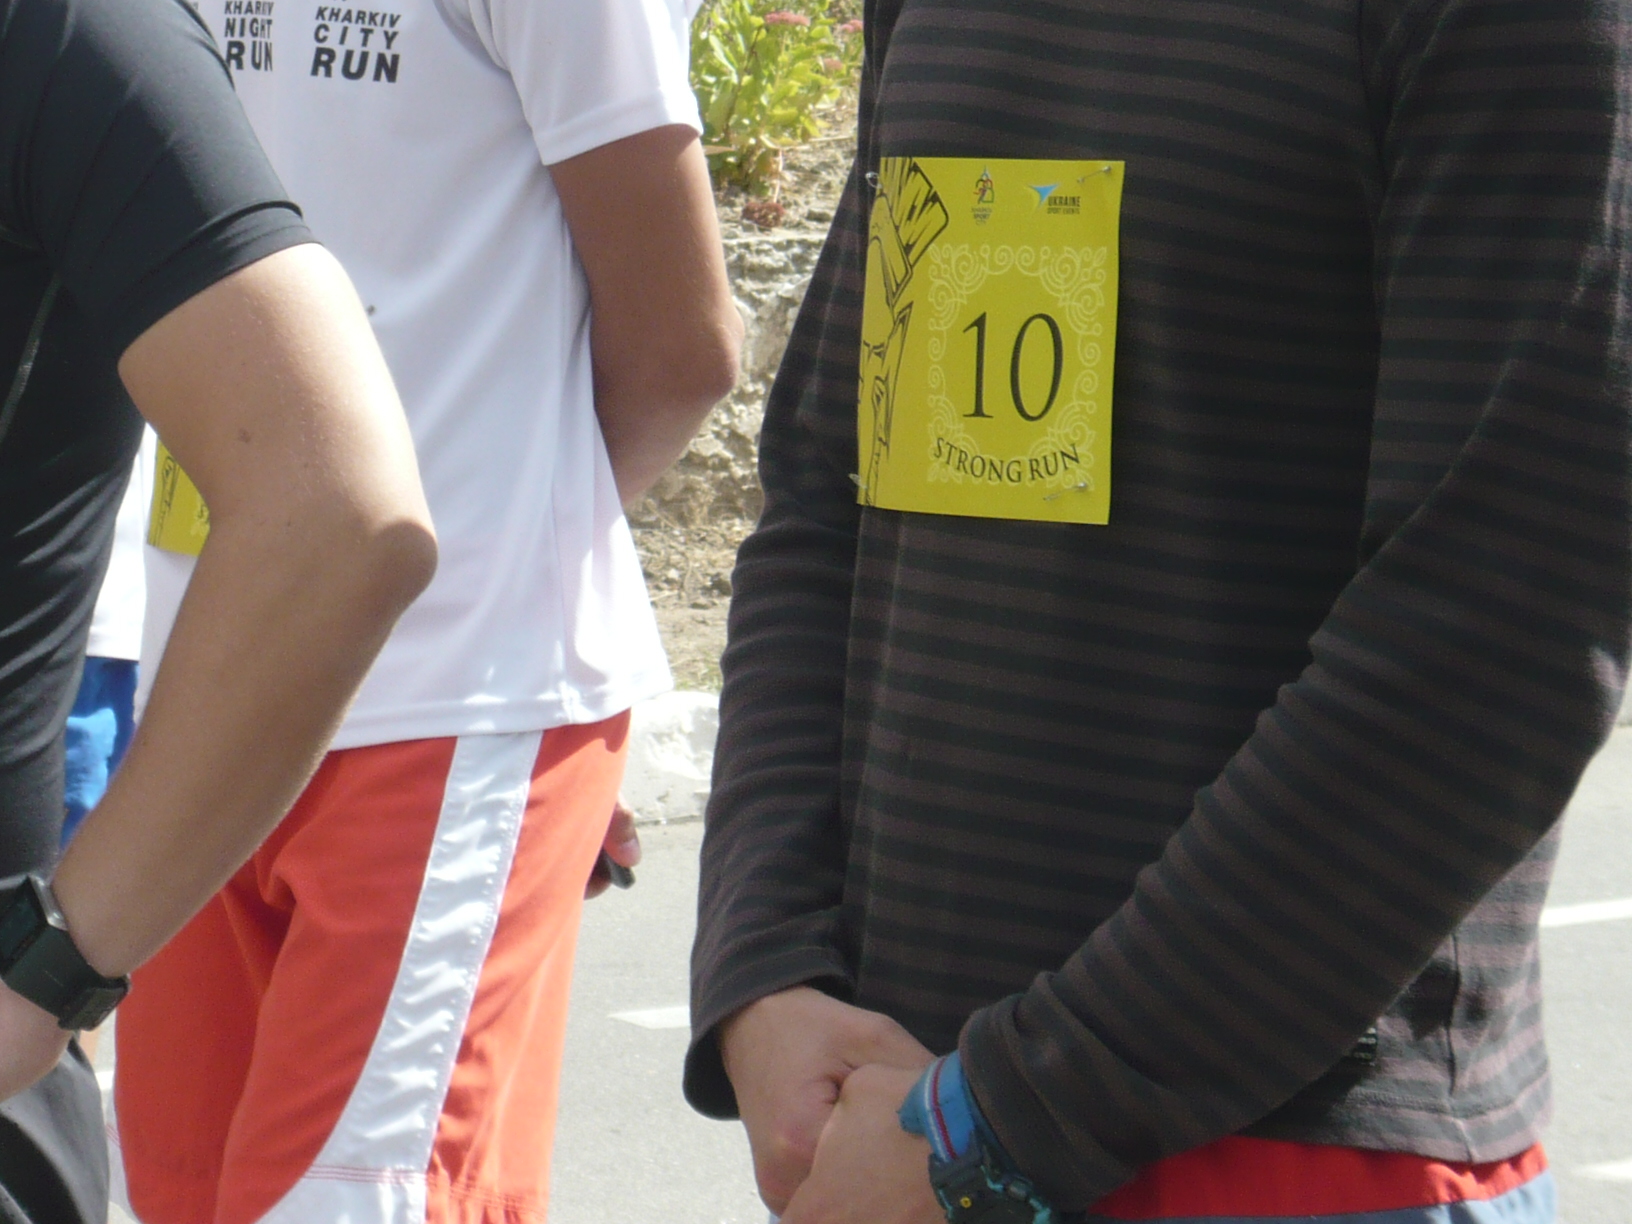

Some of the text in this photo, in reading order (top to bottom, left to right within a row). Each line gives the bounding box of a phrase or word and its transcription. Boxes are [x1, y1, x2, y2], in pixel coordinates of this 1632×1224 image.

[224, 17, 273, 39] NIGHT
[315, 6, 401, 28] KHARKIV
[313, 24, 399, 50] CITY
[225, 40, 273, 72] RUN
[310, 46, 400, 84] RUN
[1048, 195, 1081, 208] UKRAINE
[962, 311, 1064, 423] 10
[934, 437, 1081, 483] STRONG RUN
